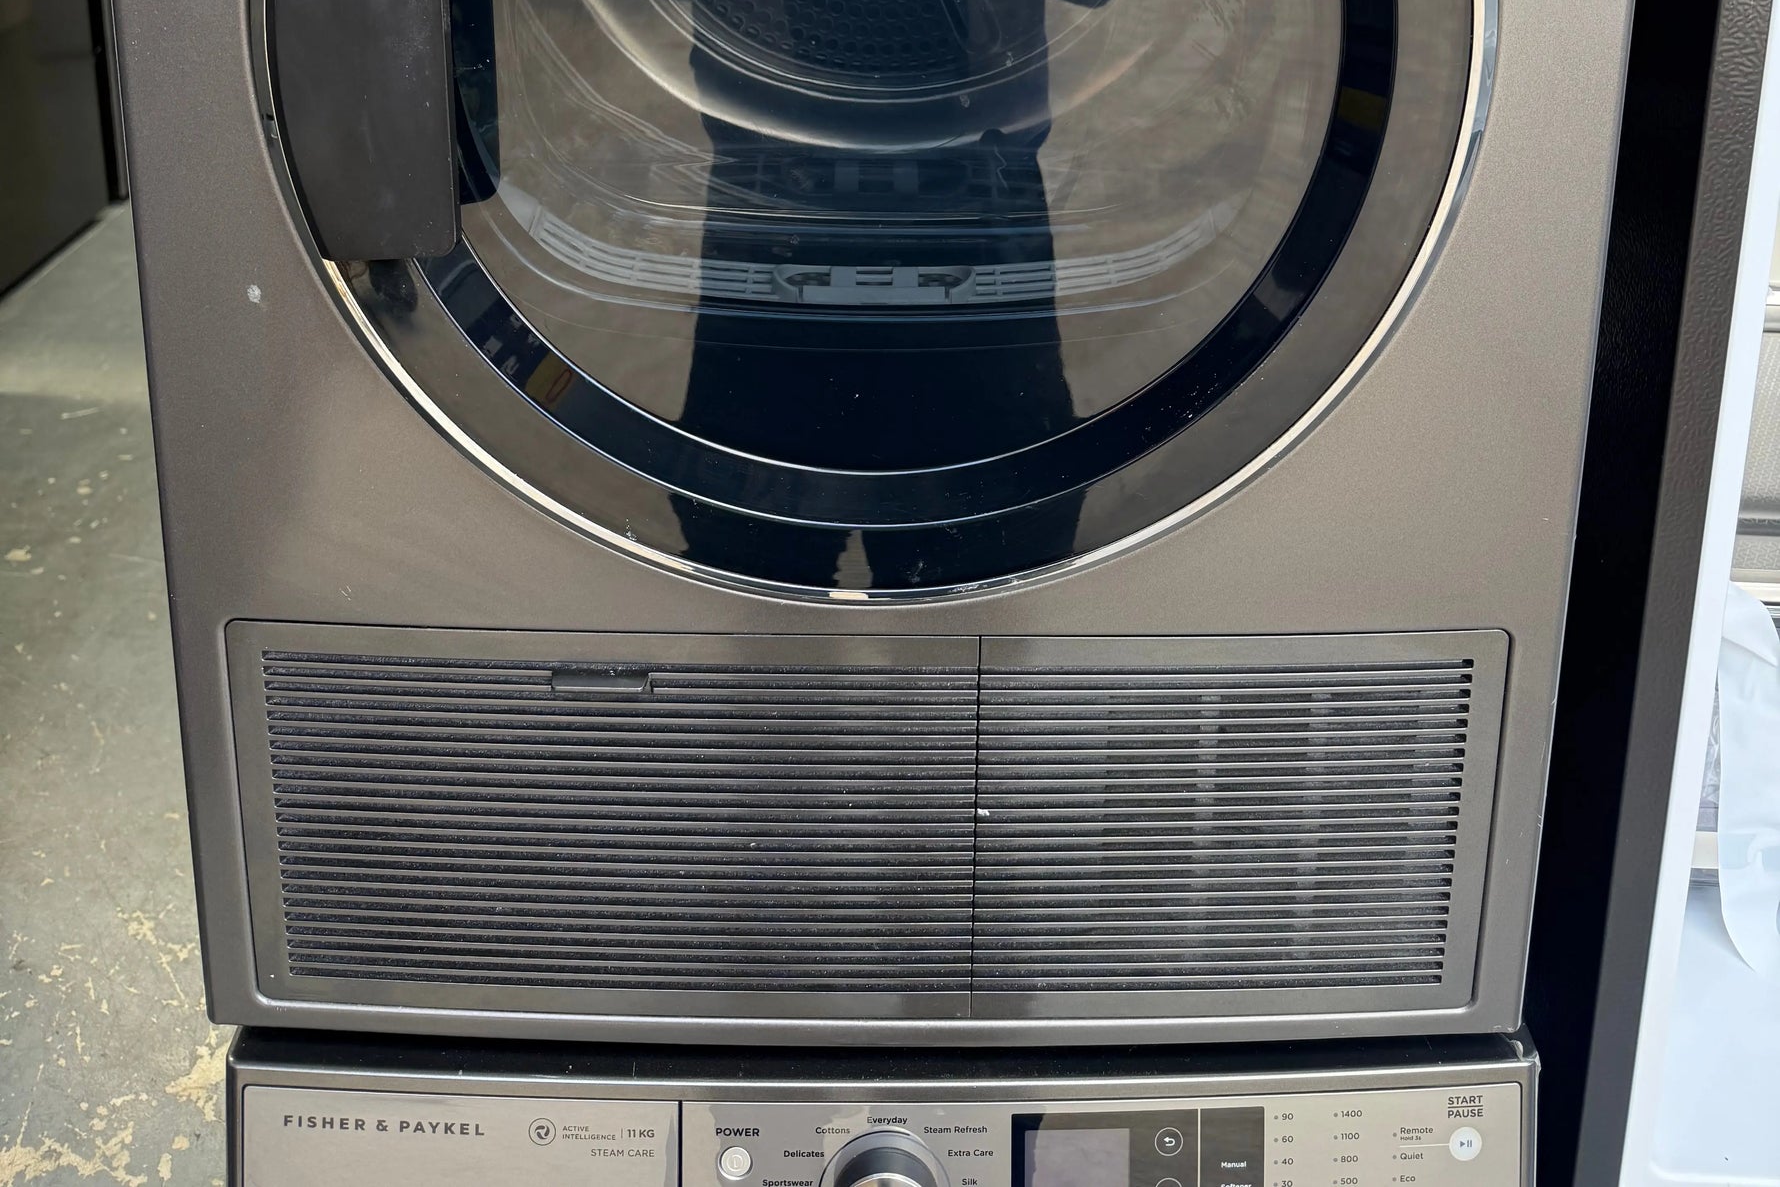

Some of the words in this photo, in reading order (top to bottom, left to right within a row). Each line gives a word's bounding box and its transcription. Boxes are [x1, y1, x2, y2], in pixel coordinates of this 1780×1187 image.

[1447, 1095, 1483, 1105] START
[1281, 1113, 1294, 1121] 90
[1341, 1110, 1362, 1118] 1400
[1447, 1108, 1484, 1118] PAUSE
[283, 1115, 366, 1131] FISHER
[375, 1120, 388, 1132] &
[400, 1120, 485, 1136] PAYKEL
[866, 1116, 908, 1127] Everyday
[627, 1129, 636, 1138] 11
[638, 1129, 655, 1138] KG
[715, 1128, 760, 1137] POWER
[815, 1126, 850, 1135] Cottons
[924, 1126, 952, 1135] Steam
[954, 1126, 988, 1134] Refresh
[1400, 1126, 1433, 1135] Remote
[562, 1133, 616, 1141] INTELLIGENCE
[1281, 1136, 1294, 1144] 60
[1341, 1133, 1360, 1141] 1100
[590, 1148, 625, 1157] STEAM
[628, 1149, 655, 1157] CARE
[783, 1150, 824, 1158] Delicates
[948, 1149, 969, 1158] Extra
[971, 1149, 994, 1157] Care
[1400, 1152, 1424, 1160] Quiet
[1340, 1155, 1358, 1163] 800
[762, 1179, 813, 1187] Sportswear
[962, 1178, 978, 1186] Silk
[1340, 1177, 1358, 1185] 500
